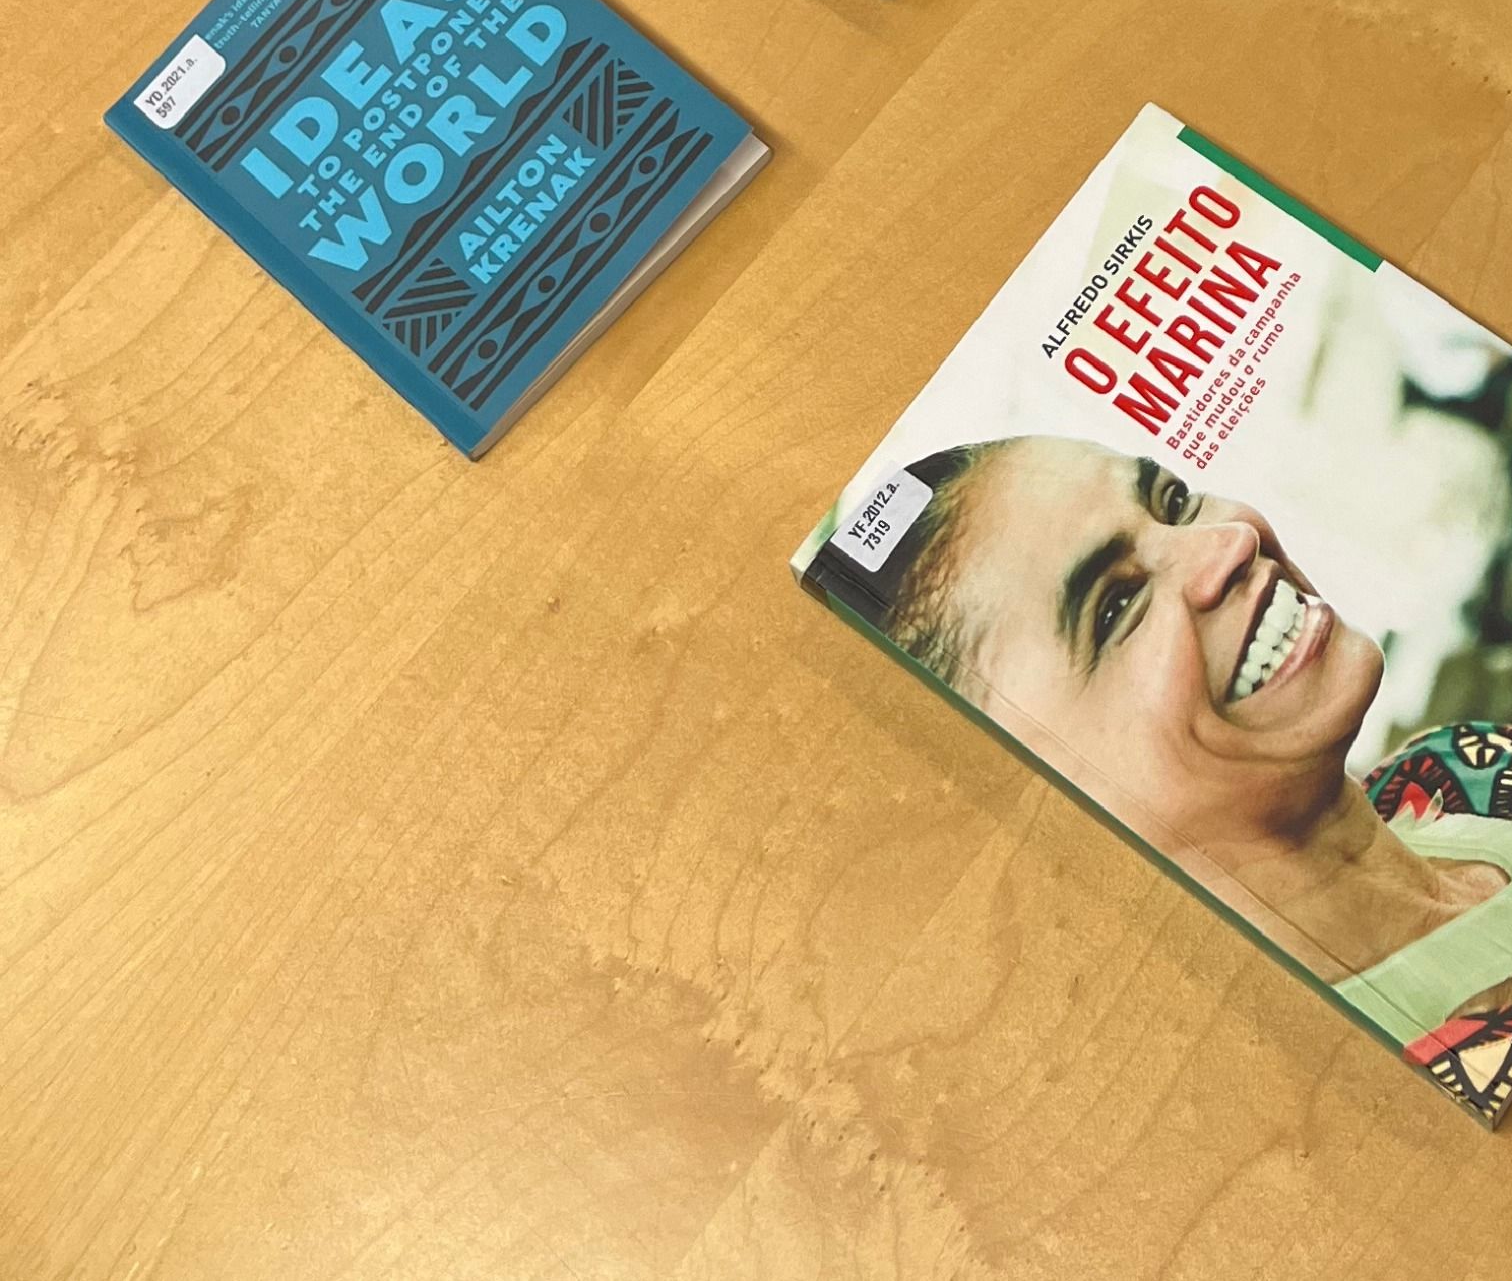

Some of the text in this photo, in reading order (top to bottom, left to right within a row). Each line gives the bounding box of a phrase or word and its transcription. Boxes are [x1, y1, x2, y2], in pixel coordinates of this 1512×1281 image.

[155, 95, 176, 119] 597
[298, 168, 364, 232] THE
[362, 103, 423, 169] END
[425, 54, 461, 98] OF
[307, 4, 567, 271] WORLD
[296, 155, 341, 198] TO
[458, 133, 568, 261] AILTON
[468, 146, 596, 284] KRENAK
[1041, 214, 1153, 359] ALFREDO SIRKIS
[1064, 185, 1241, 395] O EFEITO
[1111, 241, 1282, 437] MARINA
[1165, 272, 1302, 451] Bastidores da campanha
[1182, 323, 1284, 460] que mudou o rumo
[1196, 377, 1266, 470] das eleições
[847, 483, 900, 539] YF.2012.a.
[862, 519, 891, 551] 7319
